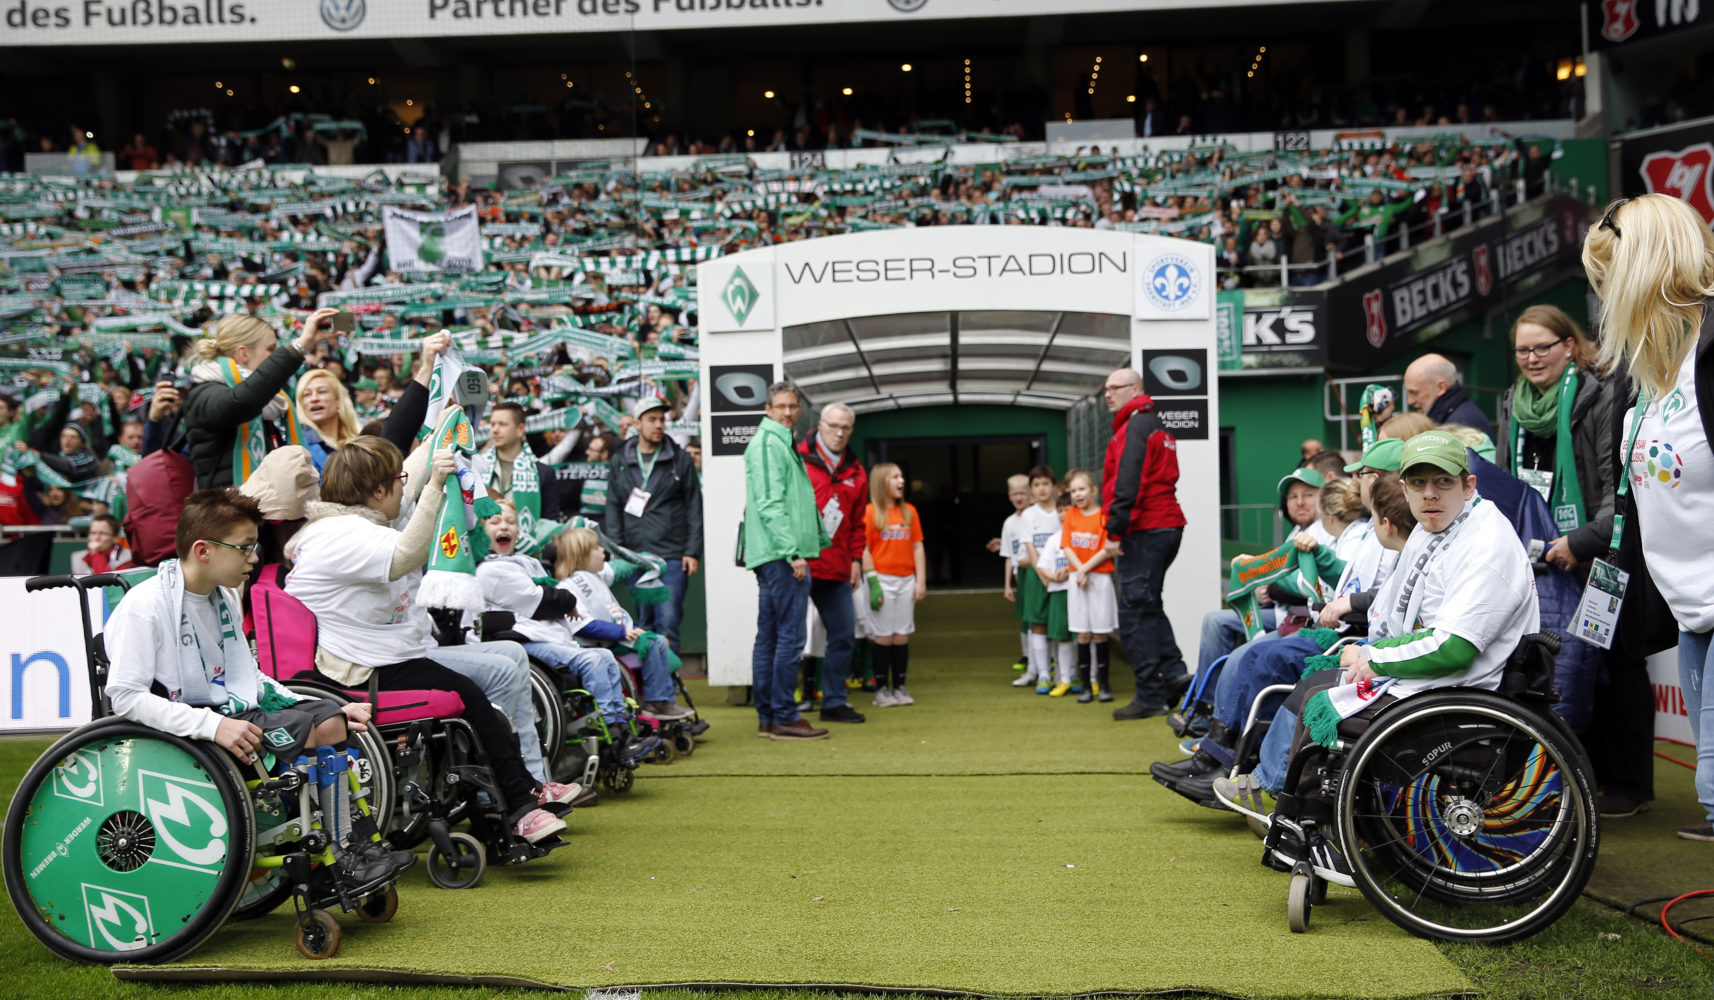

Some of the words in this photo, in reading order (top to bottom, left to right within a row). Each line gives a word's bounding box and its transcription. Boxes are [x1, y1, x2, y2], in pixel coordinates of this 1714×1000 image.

[6, 0, 71, 28] des
[83, 0, 257, 26] Fußballs.
[1277, 131, 1310, 151] 122
[791, 152, 823, 169] 124
[785, 251, 1127, 285] WESER-STADION
[1392, 258, 1471, 329] BECK'S
[721, 426, 758, 436] WESE
[1407, 435, 1449, 449] WERDER
[11, 651, 70, 720] n
[1421, 741, 1453, 767] SOPUR
[63, 816, 93, 845] WERDER
[29, 850, 58, 879] BREMEN
